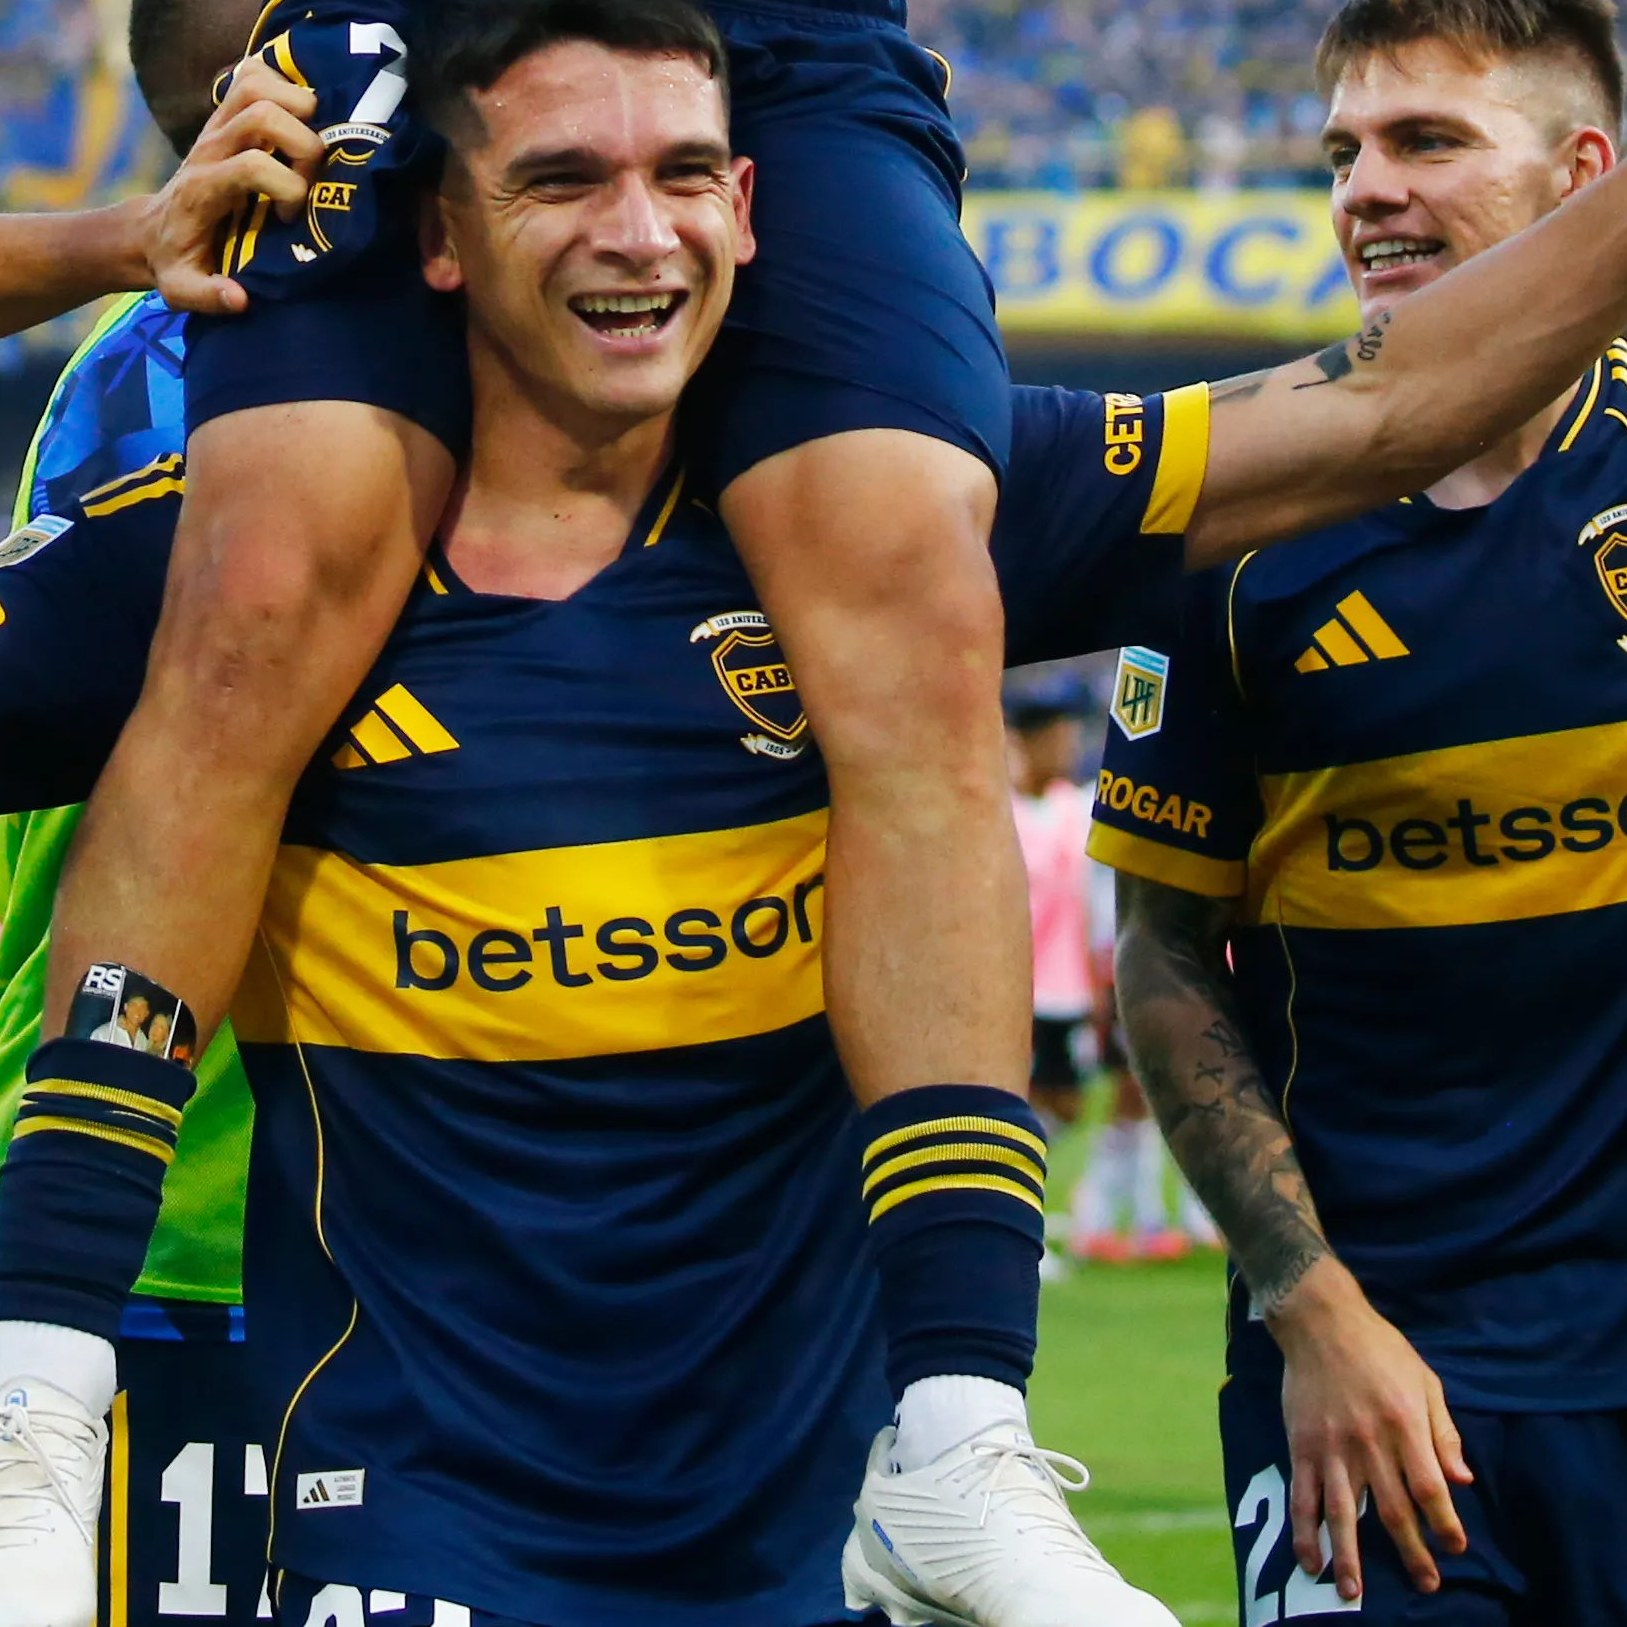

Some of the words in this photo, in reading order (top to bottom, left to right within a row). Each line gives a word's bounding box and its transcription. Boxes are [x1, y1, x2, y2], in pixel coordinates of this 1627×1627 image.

[317, 185, 352, 206] CA
[982, 210, 1351, 310] BOC
[735, 667, 791, 692] CAB
[158, 1443, 272, 1617] 1
